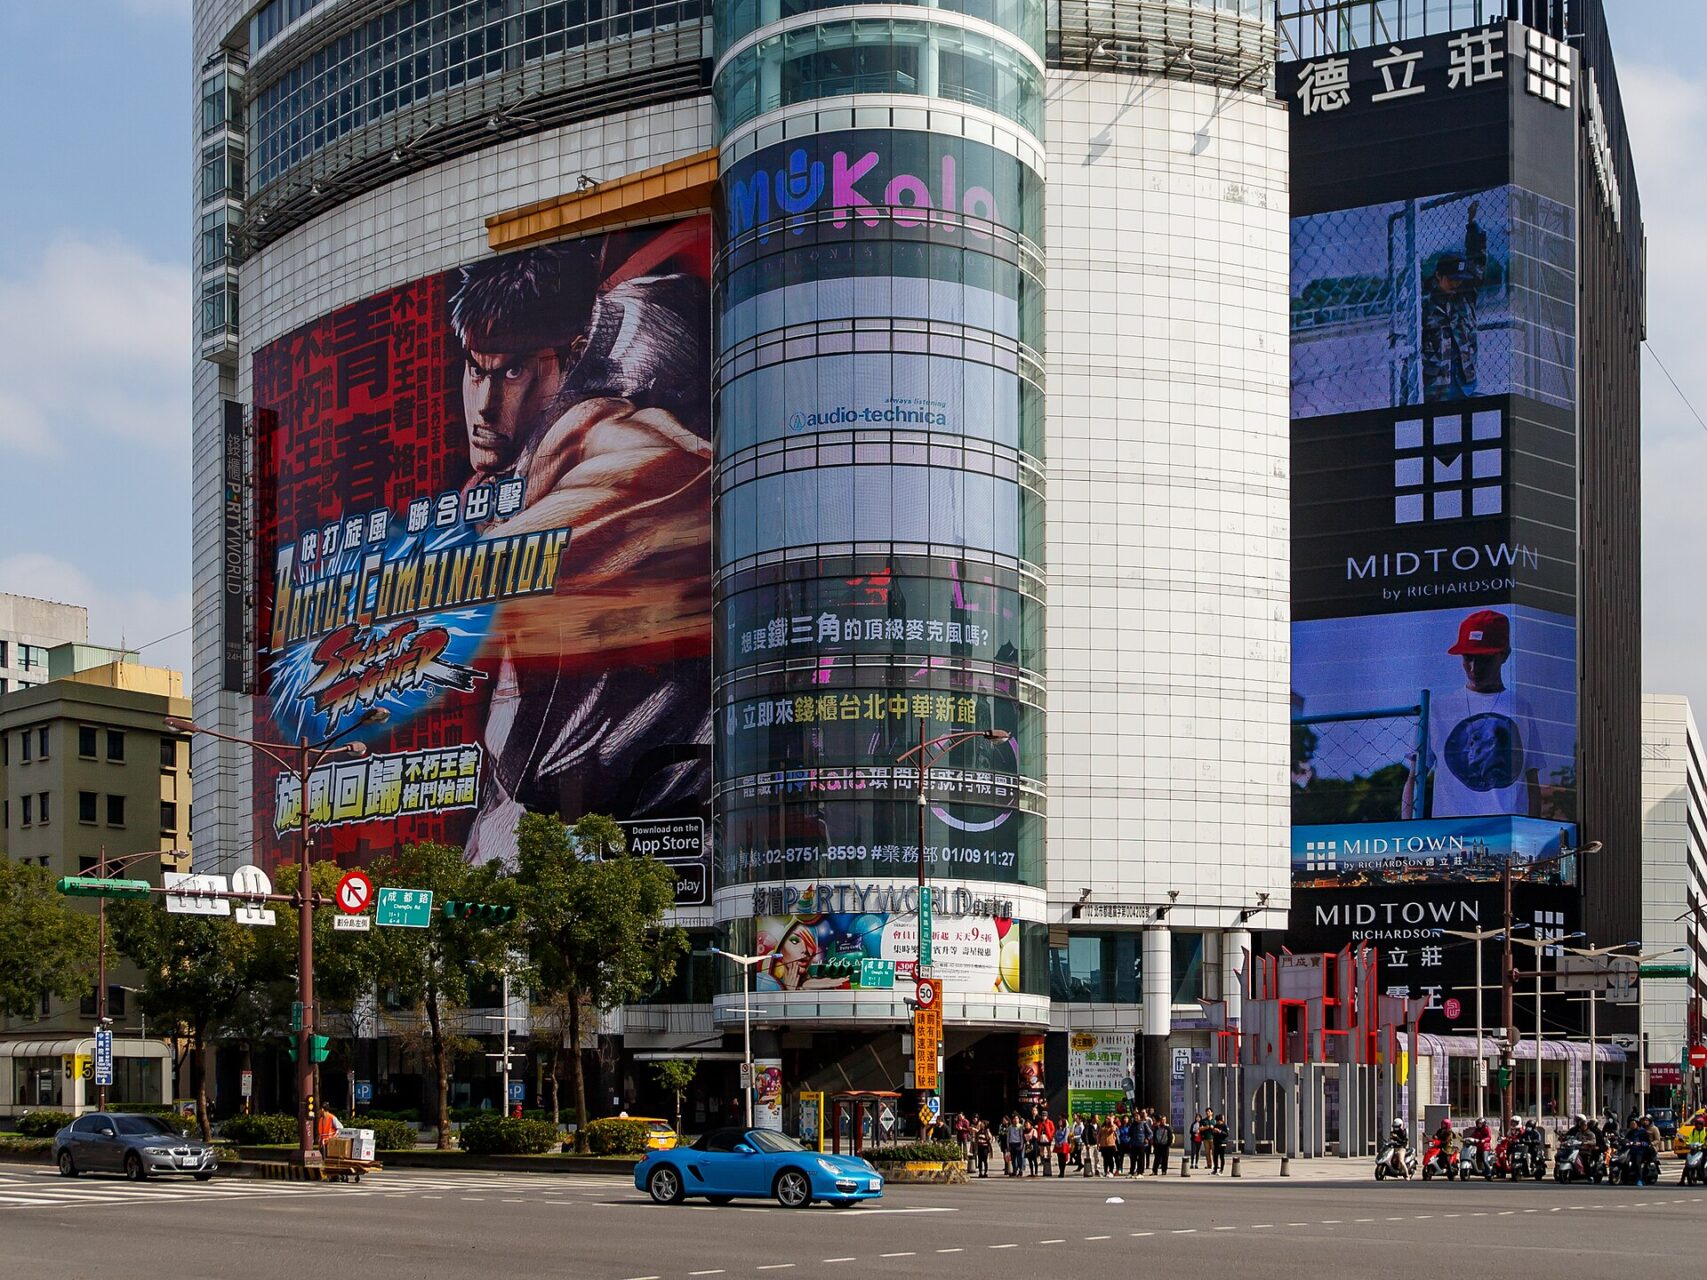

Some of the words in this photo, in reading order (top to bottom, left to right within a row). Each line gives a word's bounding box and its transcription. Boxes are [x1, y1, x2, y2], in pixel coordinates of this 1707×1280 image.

[1297, 28, 1504, 116] 德立莊
[807, 405, 946, 427] audio-technica
[301, 509, 388, 562] 快打旋風
[407, 482, 523, 533] 聯合出擊
[1347, 543, 1538, 580] MIDTOWN
[1383, 588, 1401, 600] by
[1407, 577, 1517, 597] RICHARDSON
[741, 612, 989, 654] 想要鐵三角的頂級麥克風嗎?
[742, 693, 977, 731] 立即來錢櫃台北中華新館
[405, 750, 478, 783] 不朽王者
[402, 775, 475, 809] 格鬥始祖
[632, 824, 671, 835] Download
[685, 824, 699, 832] the
[632, 837, 661, 855] App
[662, 835, 700, 851] Store
[1343, 835, 1464, 855] MIDTOWN
[983, 848, 1015, 867] 11:27
[1343, 861, 1355, 870] by
[1358, 858, 1423, 870] RICHARDSON
[677, 878, 701, 894] play
[387, 891, 429, 904] 成都路
[1315, 900, 1479, 926] MIDTOWN
[1352, 928, 1442, 940] RICHARDSON
[920, 988, 932, 999] 50
[927, 1012, 936, 1087] 前有測速照相
[65, 1061, 72, 1079] 5
[82, 1061, 94, 1080] 5
